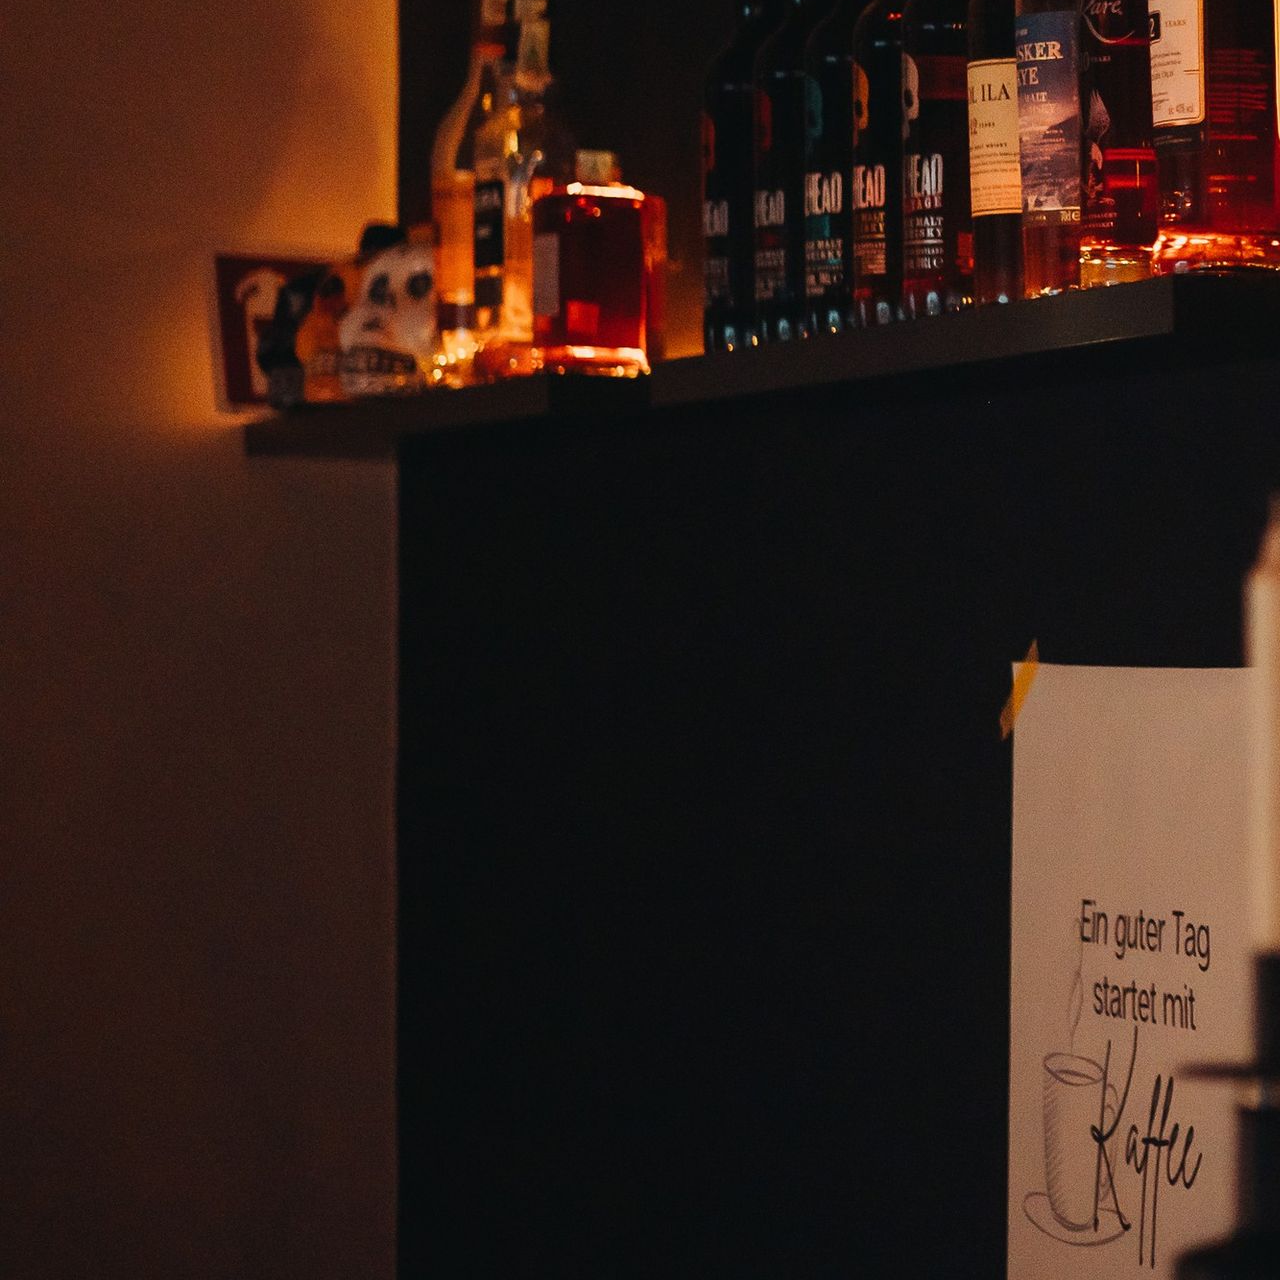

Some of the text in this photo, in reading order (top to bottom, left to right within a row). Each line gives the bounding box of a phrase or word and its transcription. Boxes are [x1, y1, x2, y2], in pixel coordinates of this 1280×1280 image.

[981, 83, 1011, 102] ILA
[1080, 898, 1211, 972] Ein guter Tag
[1093, 976, 1197, 1031] startet mit
[1090, 1026, 1203, 1270] Kaffee
